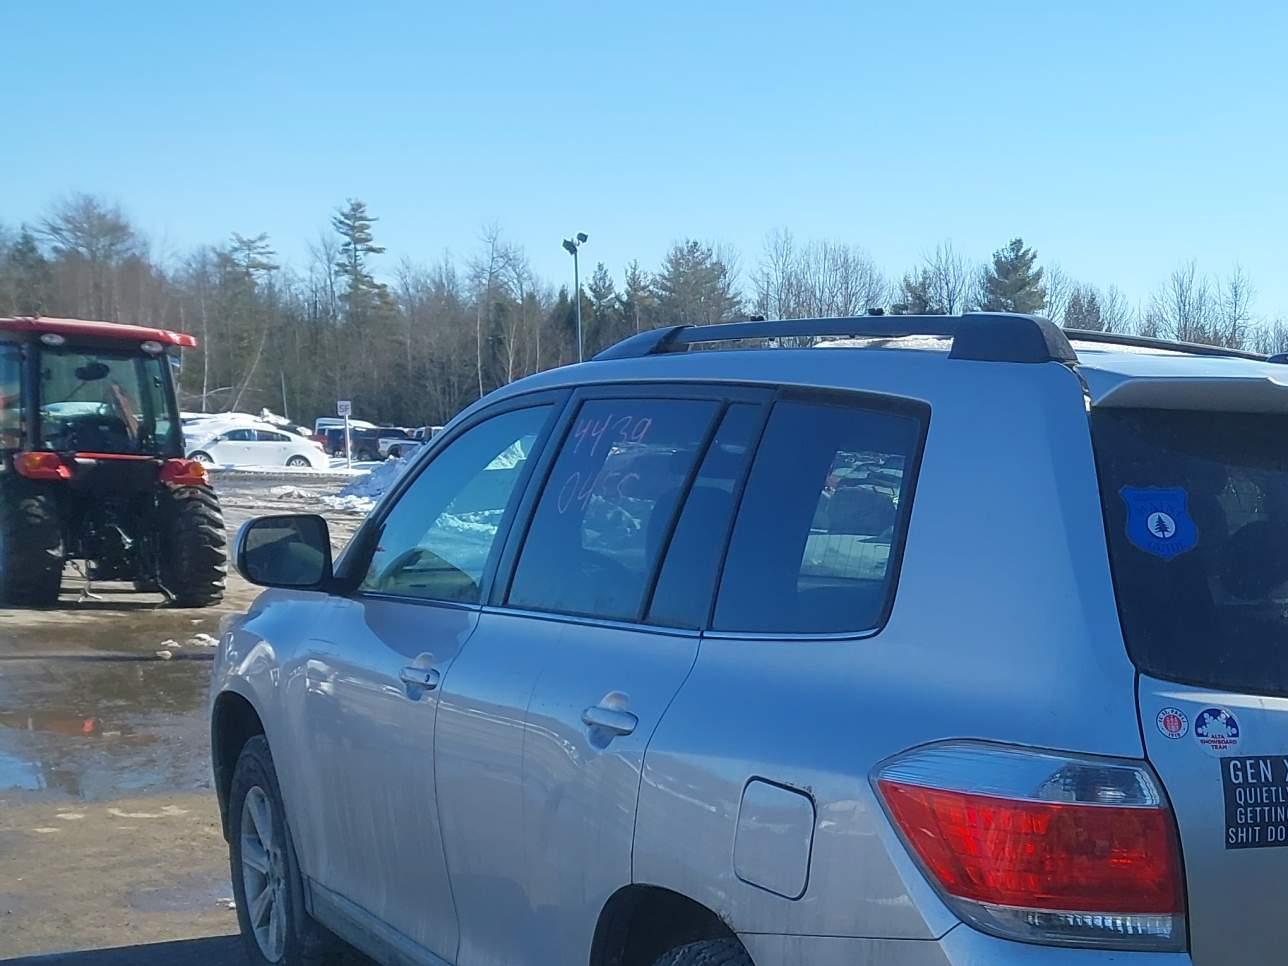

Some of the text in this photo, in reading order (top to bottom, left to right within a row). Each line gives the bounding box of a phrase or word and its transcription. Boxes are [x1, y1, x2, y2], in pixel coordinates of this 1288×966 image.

[573, 414, 653, 456] 4439
[1229, 759, 1273, 783] GEN
[1228, 826, 1261, 844] SHIT
